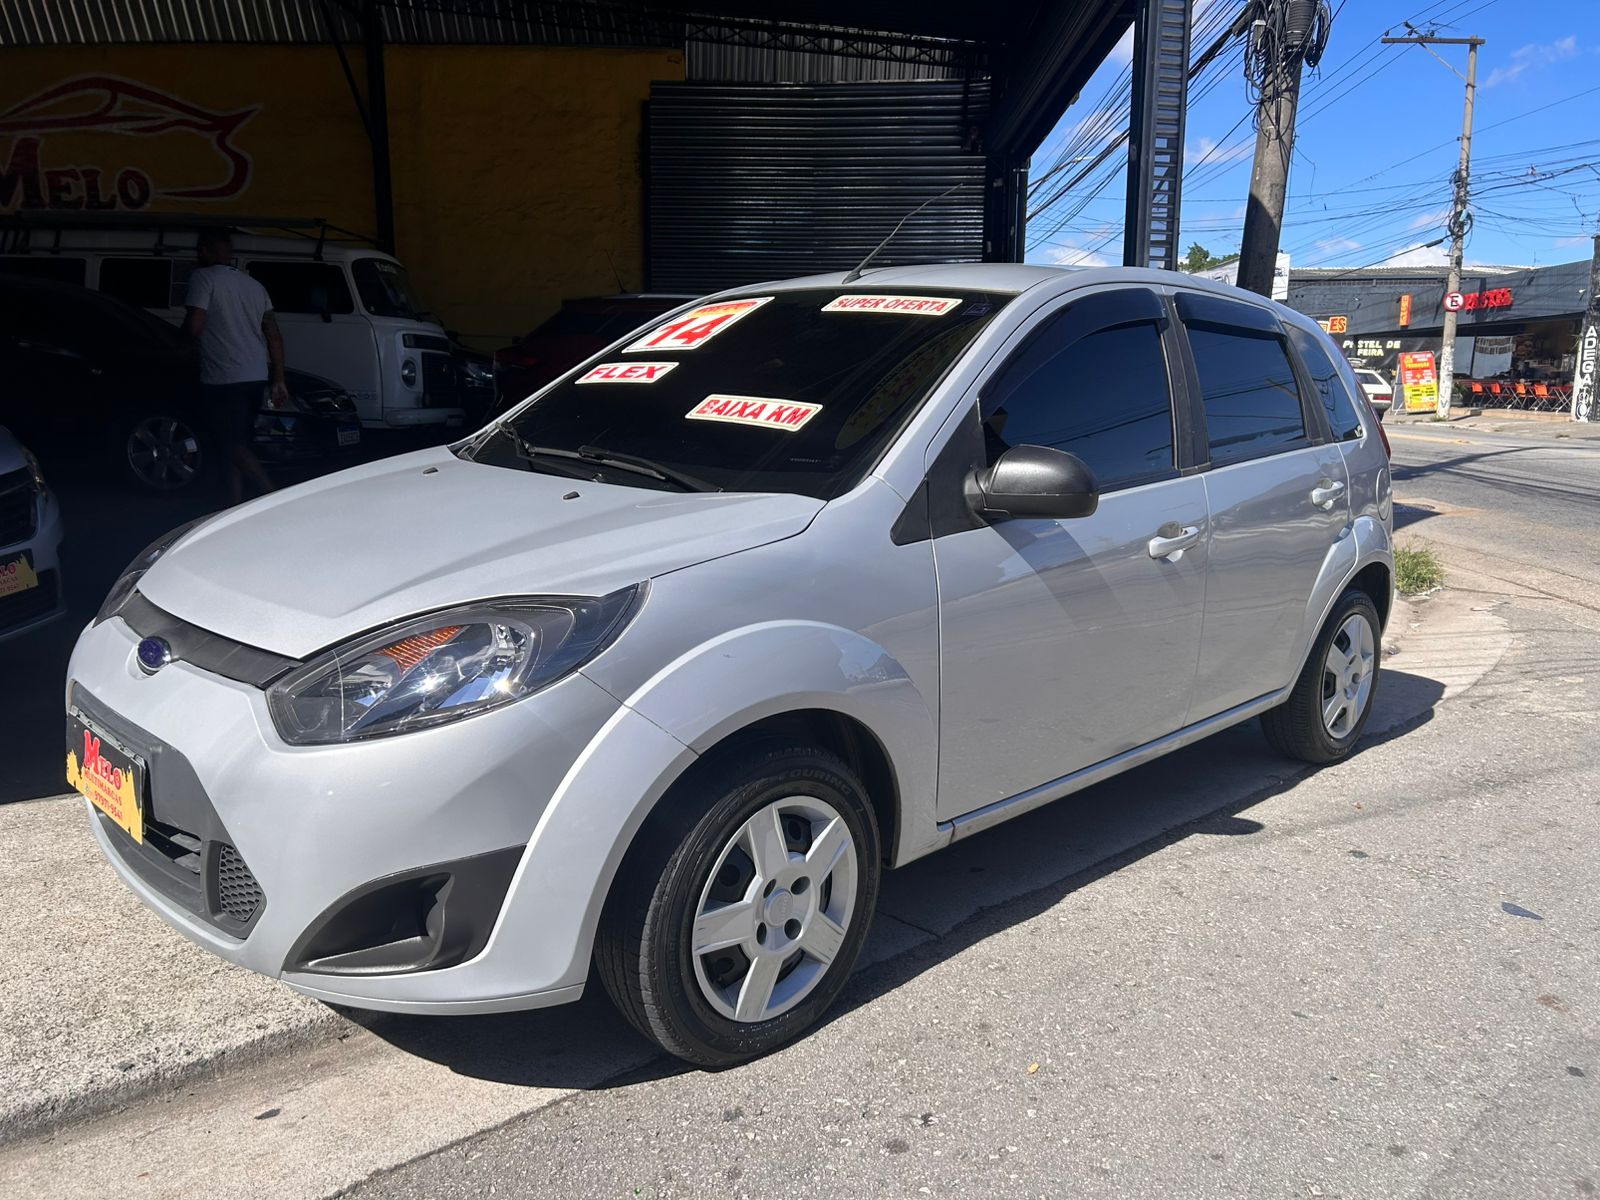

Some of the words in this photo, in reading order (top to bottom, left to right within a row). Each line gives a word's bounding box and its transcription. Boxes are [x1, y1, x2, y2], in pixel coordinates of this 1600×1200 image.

[834, 298, 885, 309] SUPER
[885, 299, 949, 313] OFERTA
[1450, 295, 1460, 308] E
[646, 313, 736, 347] 14
[1386, 340, 1402, 349] DE
[1356, 348, 1385, 357] FEIRA
[1581, 325, 1598, 386] ADEGA
[584, 366, 669, 380] FLEX
[696, 399, 766, 420] BAIXA
[766, 405, 813, 425] KM
[83, 728, 123, 791] MELO
